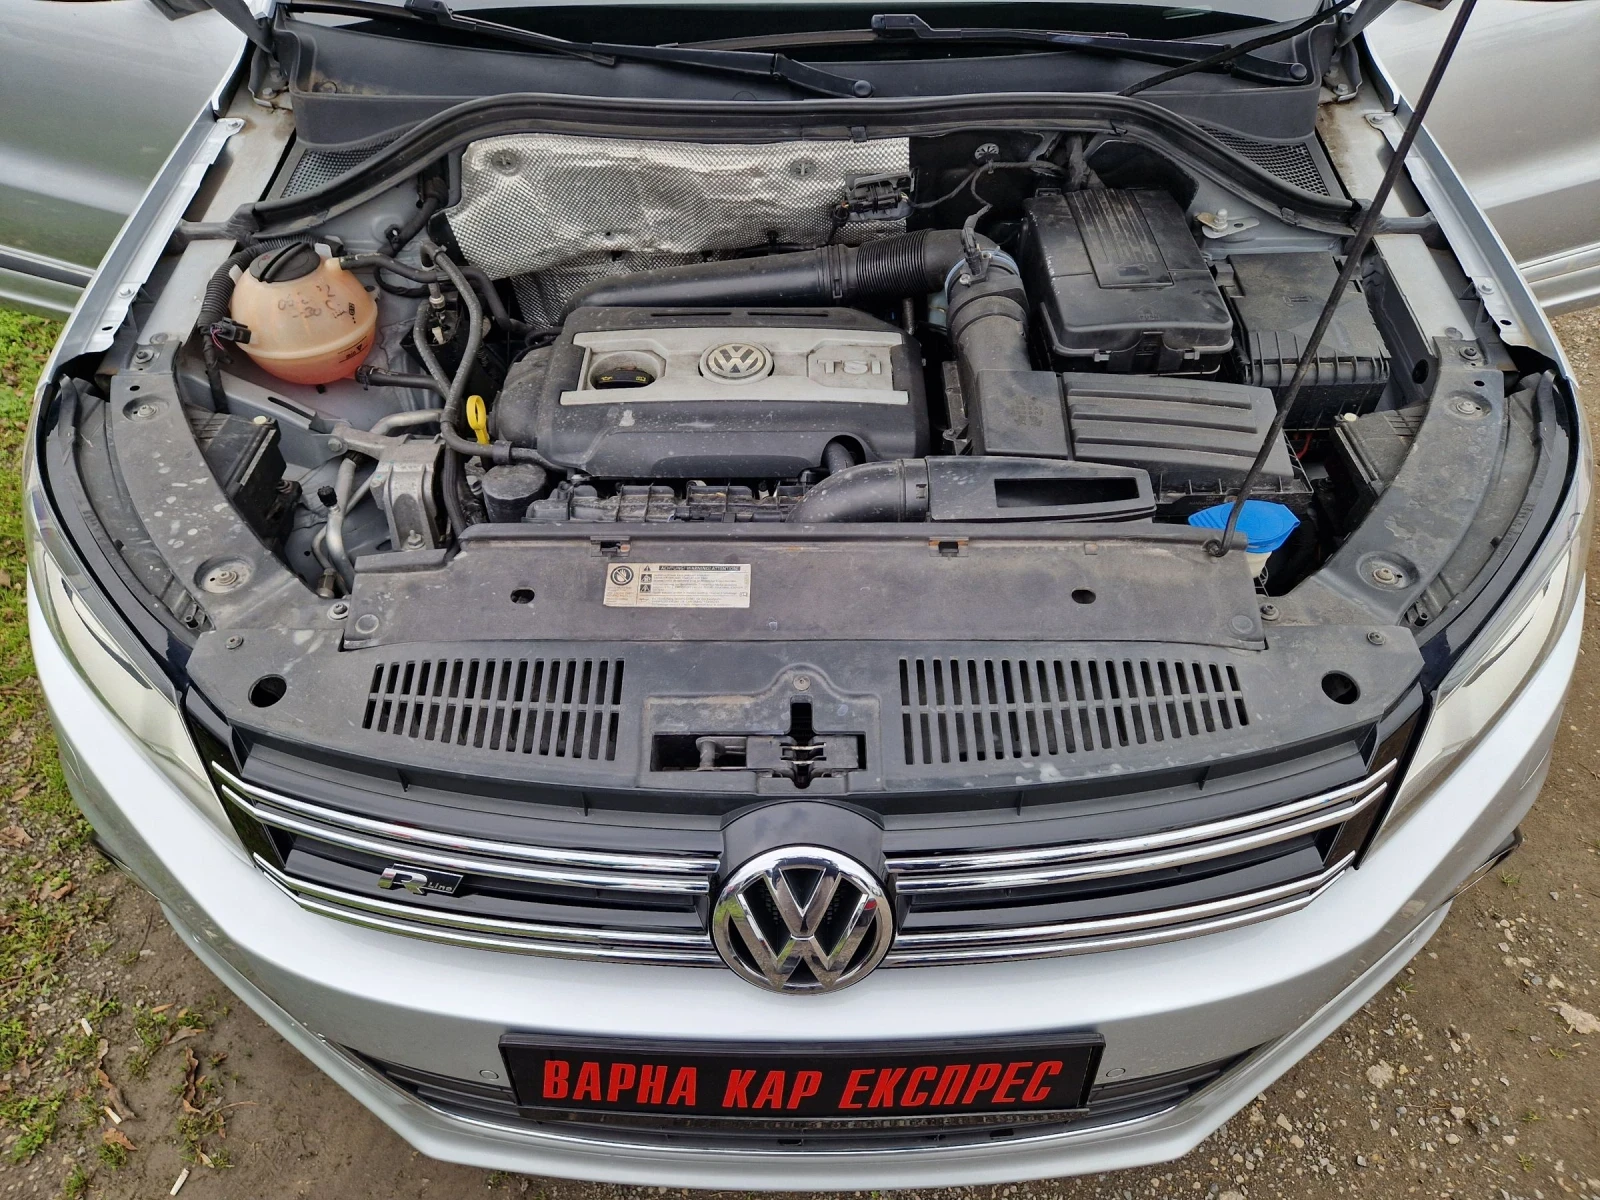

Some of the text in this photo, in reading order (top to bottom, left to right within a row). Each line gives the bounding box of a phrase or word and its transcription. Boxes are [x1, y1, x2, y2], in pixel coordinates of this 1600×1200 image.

[817, 359, 882, 375] TSI
[377, 867, 453, 895] R Line
[722, 858, 885, 990] VW
[542, 1060, 1063, 1110] ВАРНА КАР ЕКСПРЕС
